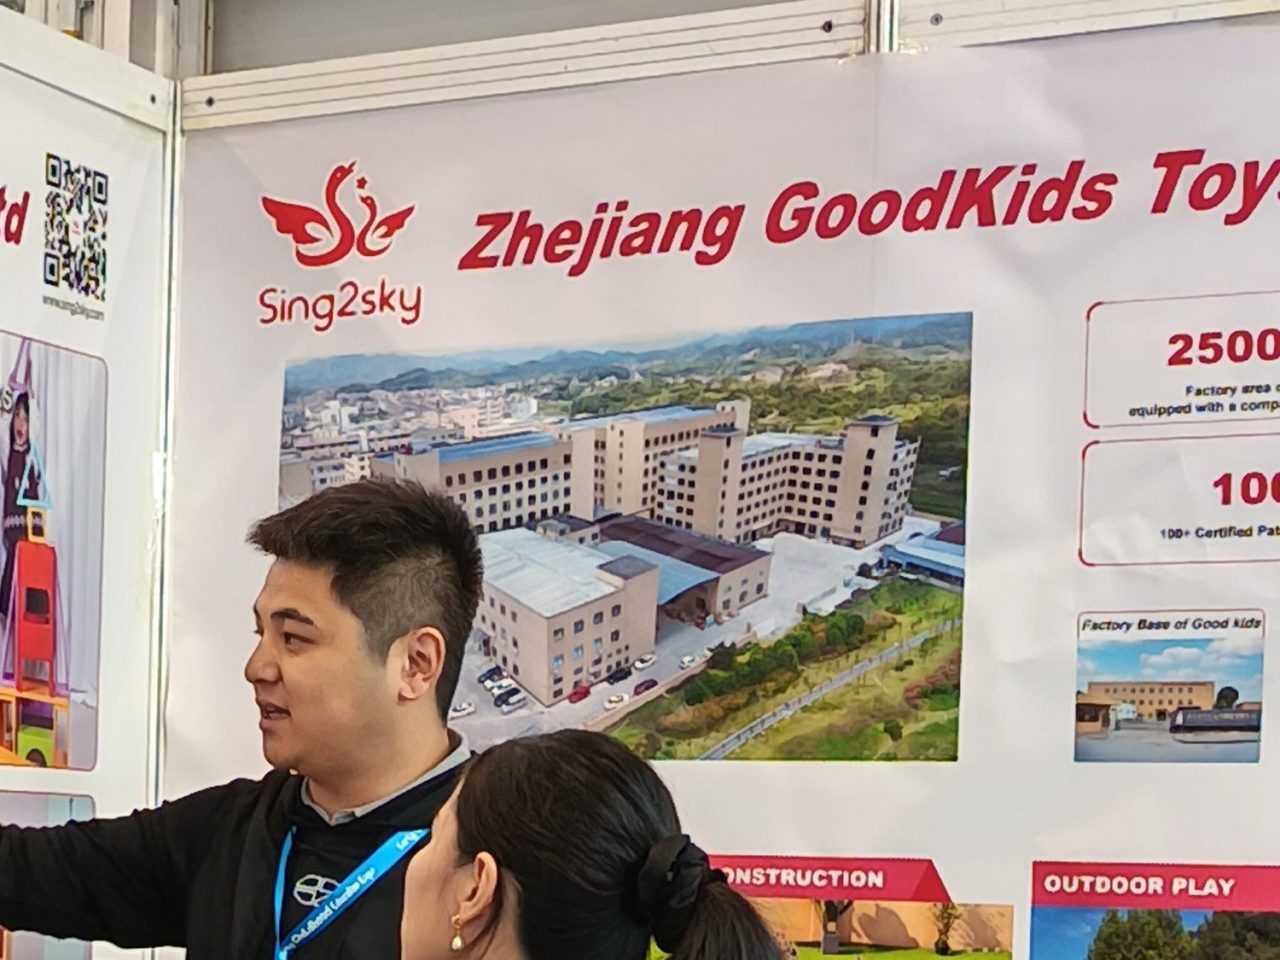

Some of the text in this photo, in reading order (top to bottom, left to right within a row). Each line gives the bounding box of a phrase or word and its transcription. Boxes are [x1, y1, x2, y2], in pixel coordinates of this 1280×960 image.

[457, 149, 1280, 277] Zhejiang GoodKids Toy
[259, 279, 422, 331] Sing2sky
[1185, 384, 1237, 397] Factory
[1242, 384, 1271, 394] area
[1129, 402, 1192, 418] equipped
[1196, 400, 1223, 412] with
[1240, 400, 1280, 413] comp
[1160, 528, 1190, 539] 100+
[1195, 525, 1253, 539] Certified
[1082, 619, 1132, 633] Factory
[1137, 619, 1170, 631] Base
[1174, 618, 1188, 631] of
[1191, 618, 1229, 630] Good
[1043, 874, 1235, 896] OUTDOOR PLAY
